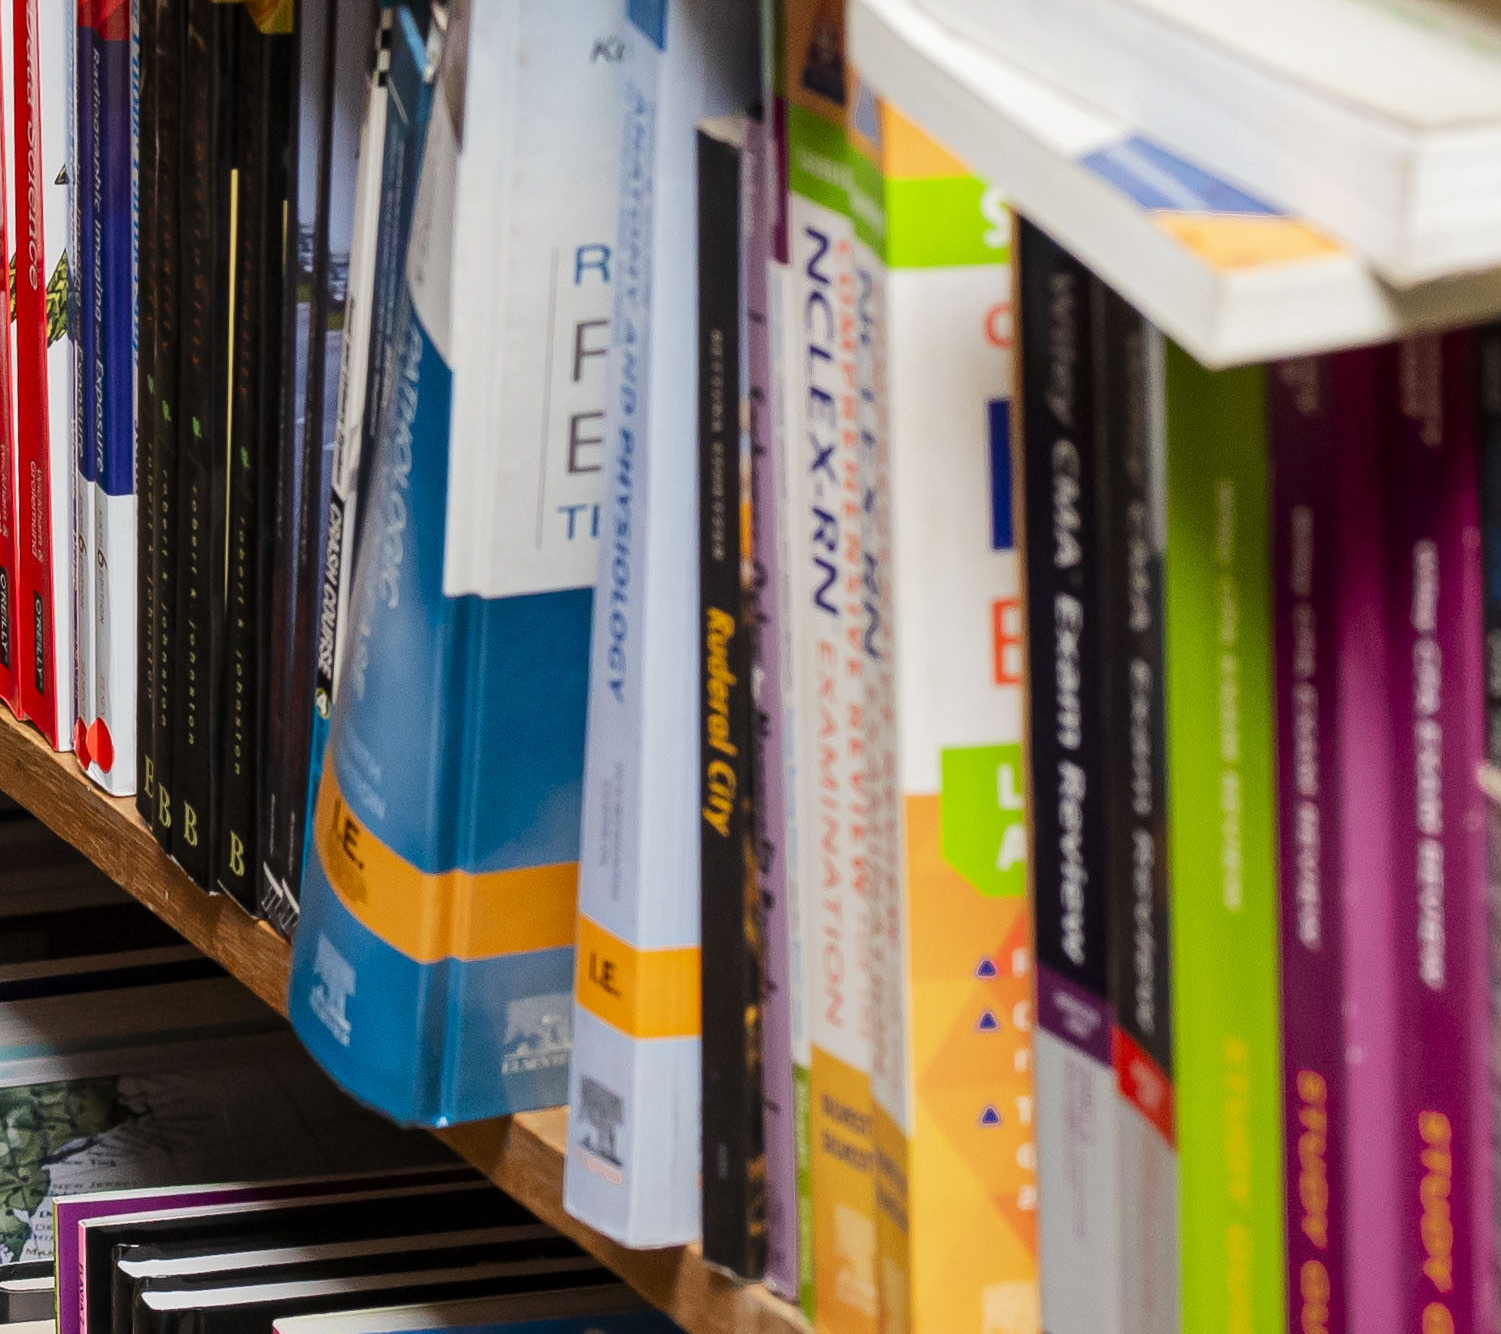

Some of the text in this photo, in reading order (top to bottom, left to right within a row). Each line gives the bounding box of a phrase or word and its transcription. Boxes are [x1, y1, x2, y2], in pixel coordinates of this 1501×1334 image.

[92, 357, 105, 473] Exposure
[804, 226, 840, 618] NCLEX-RN
[34, 598, 45, 679] O'REILLY
[318, 501, 344, 680] CRASH COURSE
[607, 426, 637, 704] PHYSIOLOGY
[233, 650, 245, 776] johnston
[702, 607, 738, 836] Ruderal City
[1052, 437, 1089, 964] CMA Exam Review
[183, 801, 199, 847] B
[229, 830, 246, 876] B
[816, 638, 844, 1030] EXAMINATION
